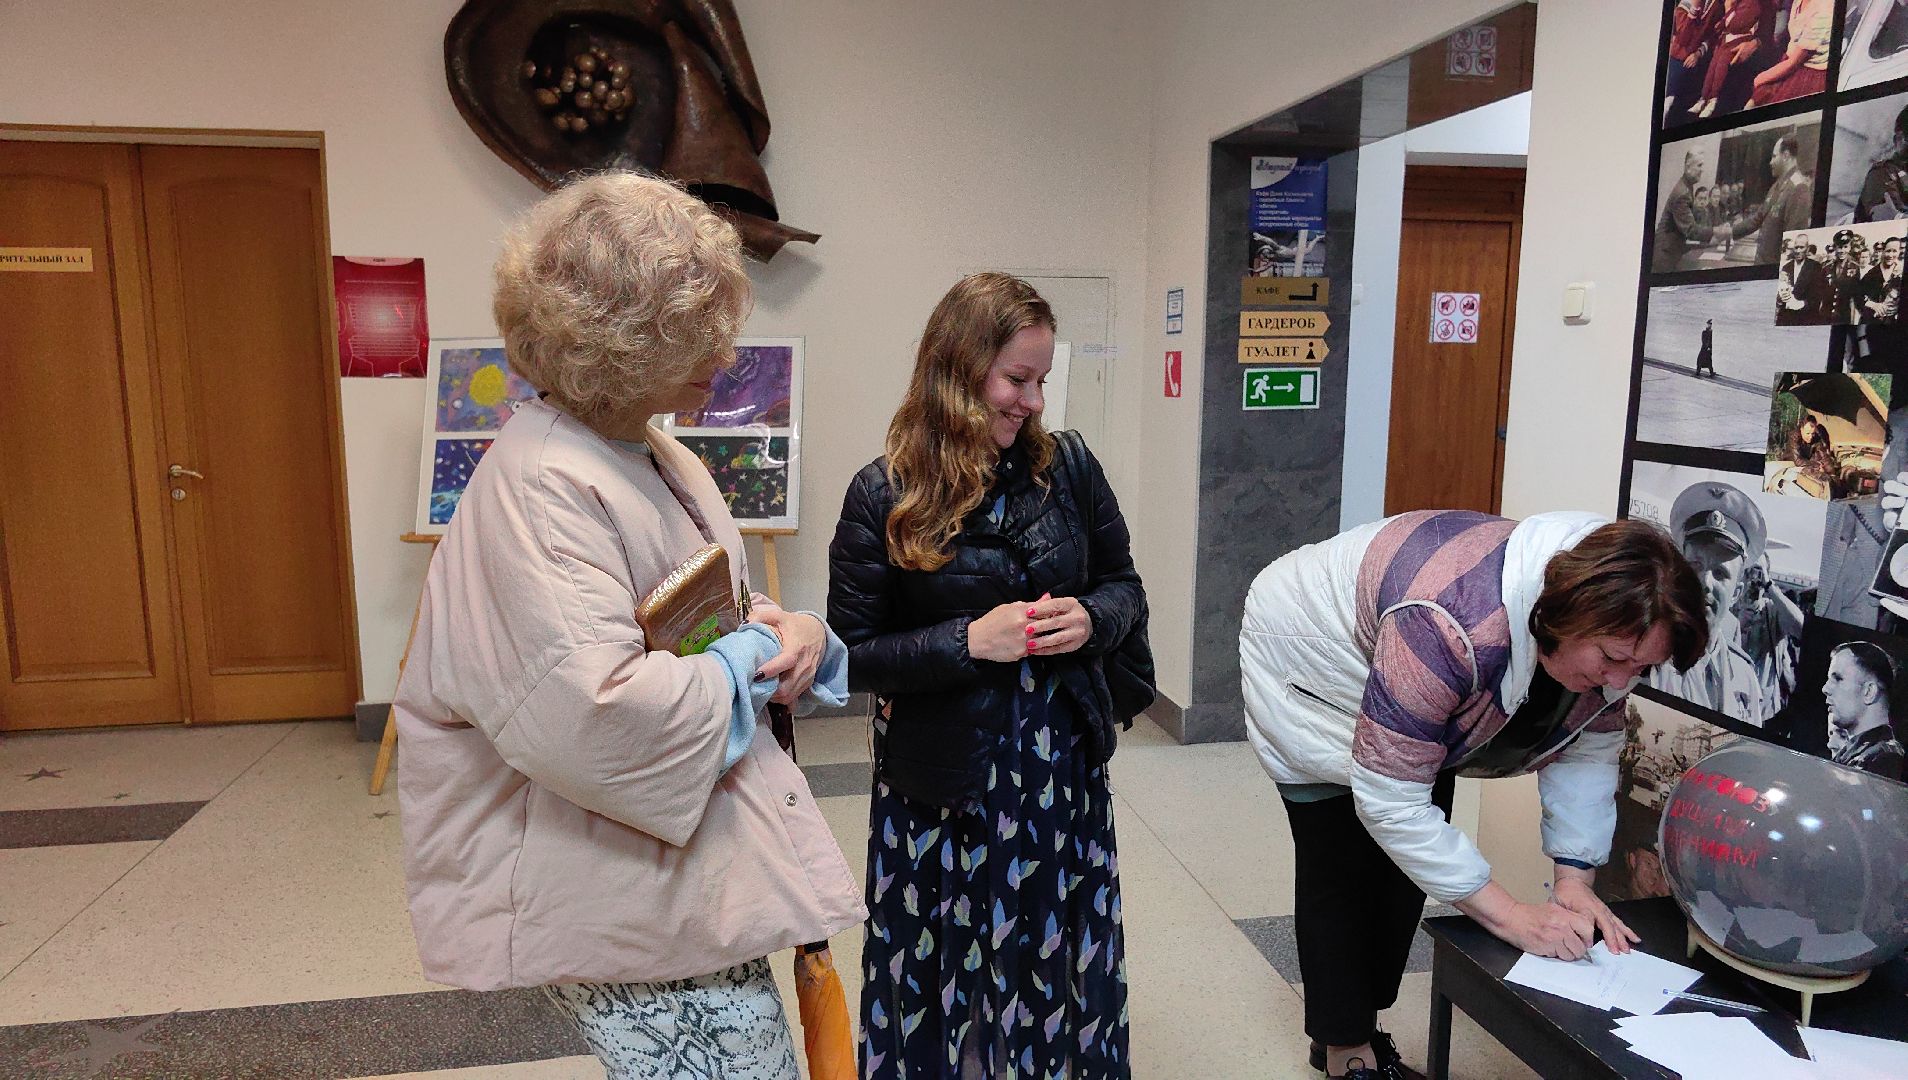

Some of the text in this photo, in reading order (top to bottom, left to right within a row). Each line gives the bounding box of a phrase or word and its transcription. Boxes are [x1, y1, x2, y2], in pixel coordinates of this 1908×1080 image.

[1256, 286, 1280, 295] КАФЕ
[1248, 318, 1316, 330] ГАРДЕРОБ
[1244, 346, 1300, 358] ТУАЛЕТ
